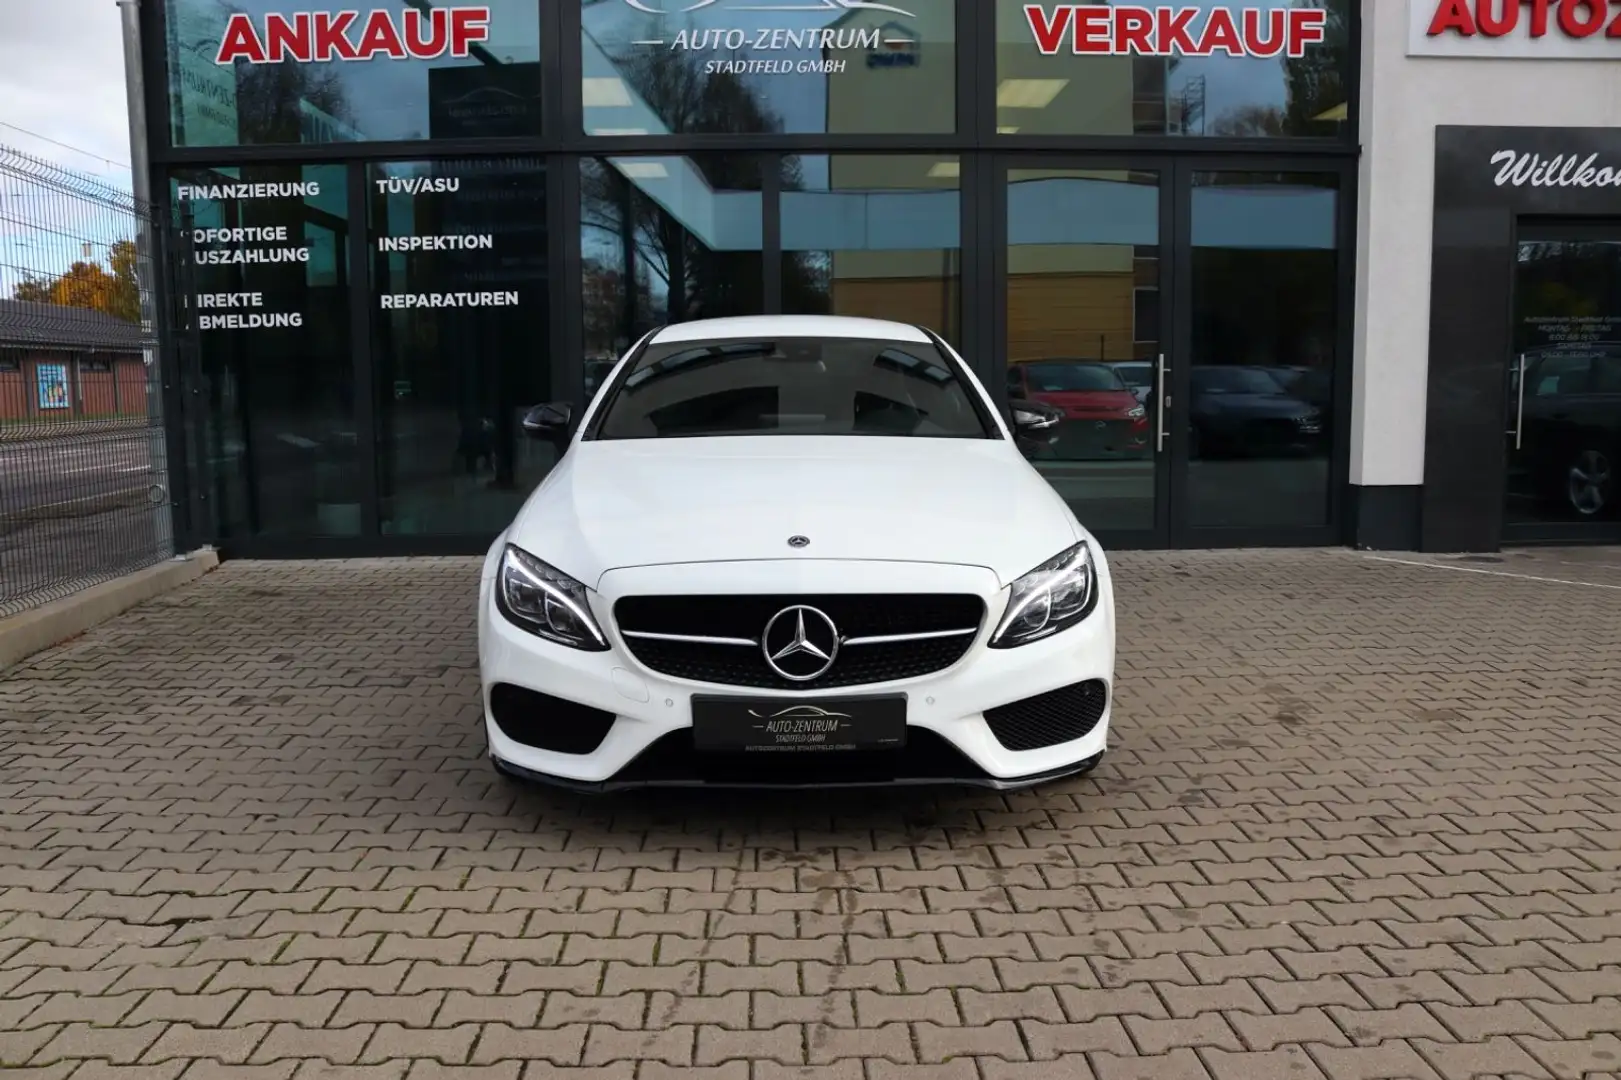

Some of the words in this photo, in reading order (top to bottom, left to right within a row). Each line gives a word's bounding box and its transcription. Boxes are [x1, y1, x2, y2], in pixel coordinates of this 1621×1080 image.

[215, 6, 490, 65] ANKAUF
[671, 28, 880, 51] AUTO-ZENTRUM
[1024, 6, 1327, 57] VERKAUF
[704, 59, 793, 74] STADTFELD
[796, 59, 846, 73] GMBH
[177, 181, 320, 200] FINANZIERUNG
[376, 176, 460, 195] TÜV/ASU
[378, 234, 493, 251] INSPEKTION
[181, 247, 310, 265] USZAHLUNG
[184, 292, 263, 309] IREKTE
[380, 290, 519, 309] REPARATUREN
[185, 312, 303, 331] BMELDUNG
[766, 719, 838, 732] AUTO-ZENTRUM
